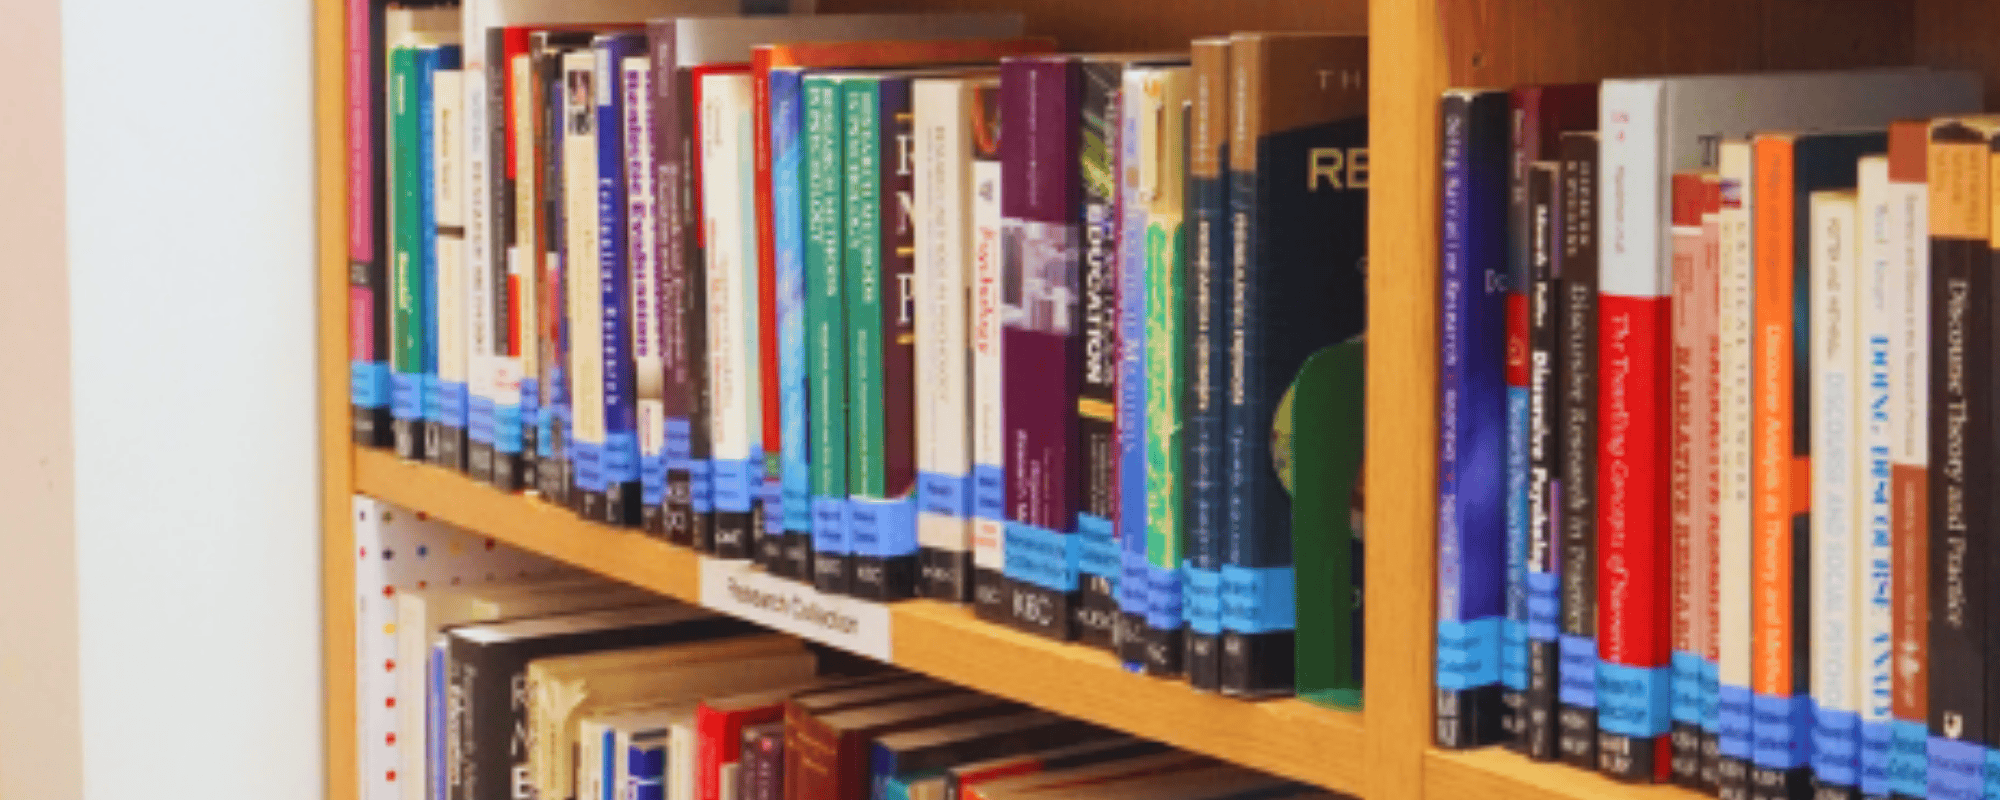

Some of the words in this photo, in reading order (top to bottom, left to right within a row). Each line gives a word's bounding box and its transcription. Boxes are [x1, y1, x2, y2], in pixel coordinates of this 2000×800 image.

[599, 178, 614, 293] Evaluating
[630, 202, 648, 358] Evaluation
[1086, 204, 1103, 384] EDUCATION
[1570, 282, 1591, 401] Discursive
[1611, 312, 1631, 353] The
[1945, 279, 1968, 395] Discourse
[604, 307, 620, 406] Research
[1532, 350, 1552, 461] Discursive
[1569, 406, 1589, 509] Research
[1943, 398, 1969, 480] Theory
[1946, 486, 1967, 530] and
[791, 596, 859, 634] Collection
[1946, 536, 1966, 628] Practice
